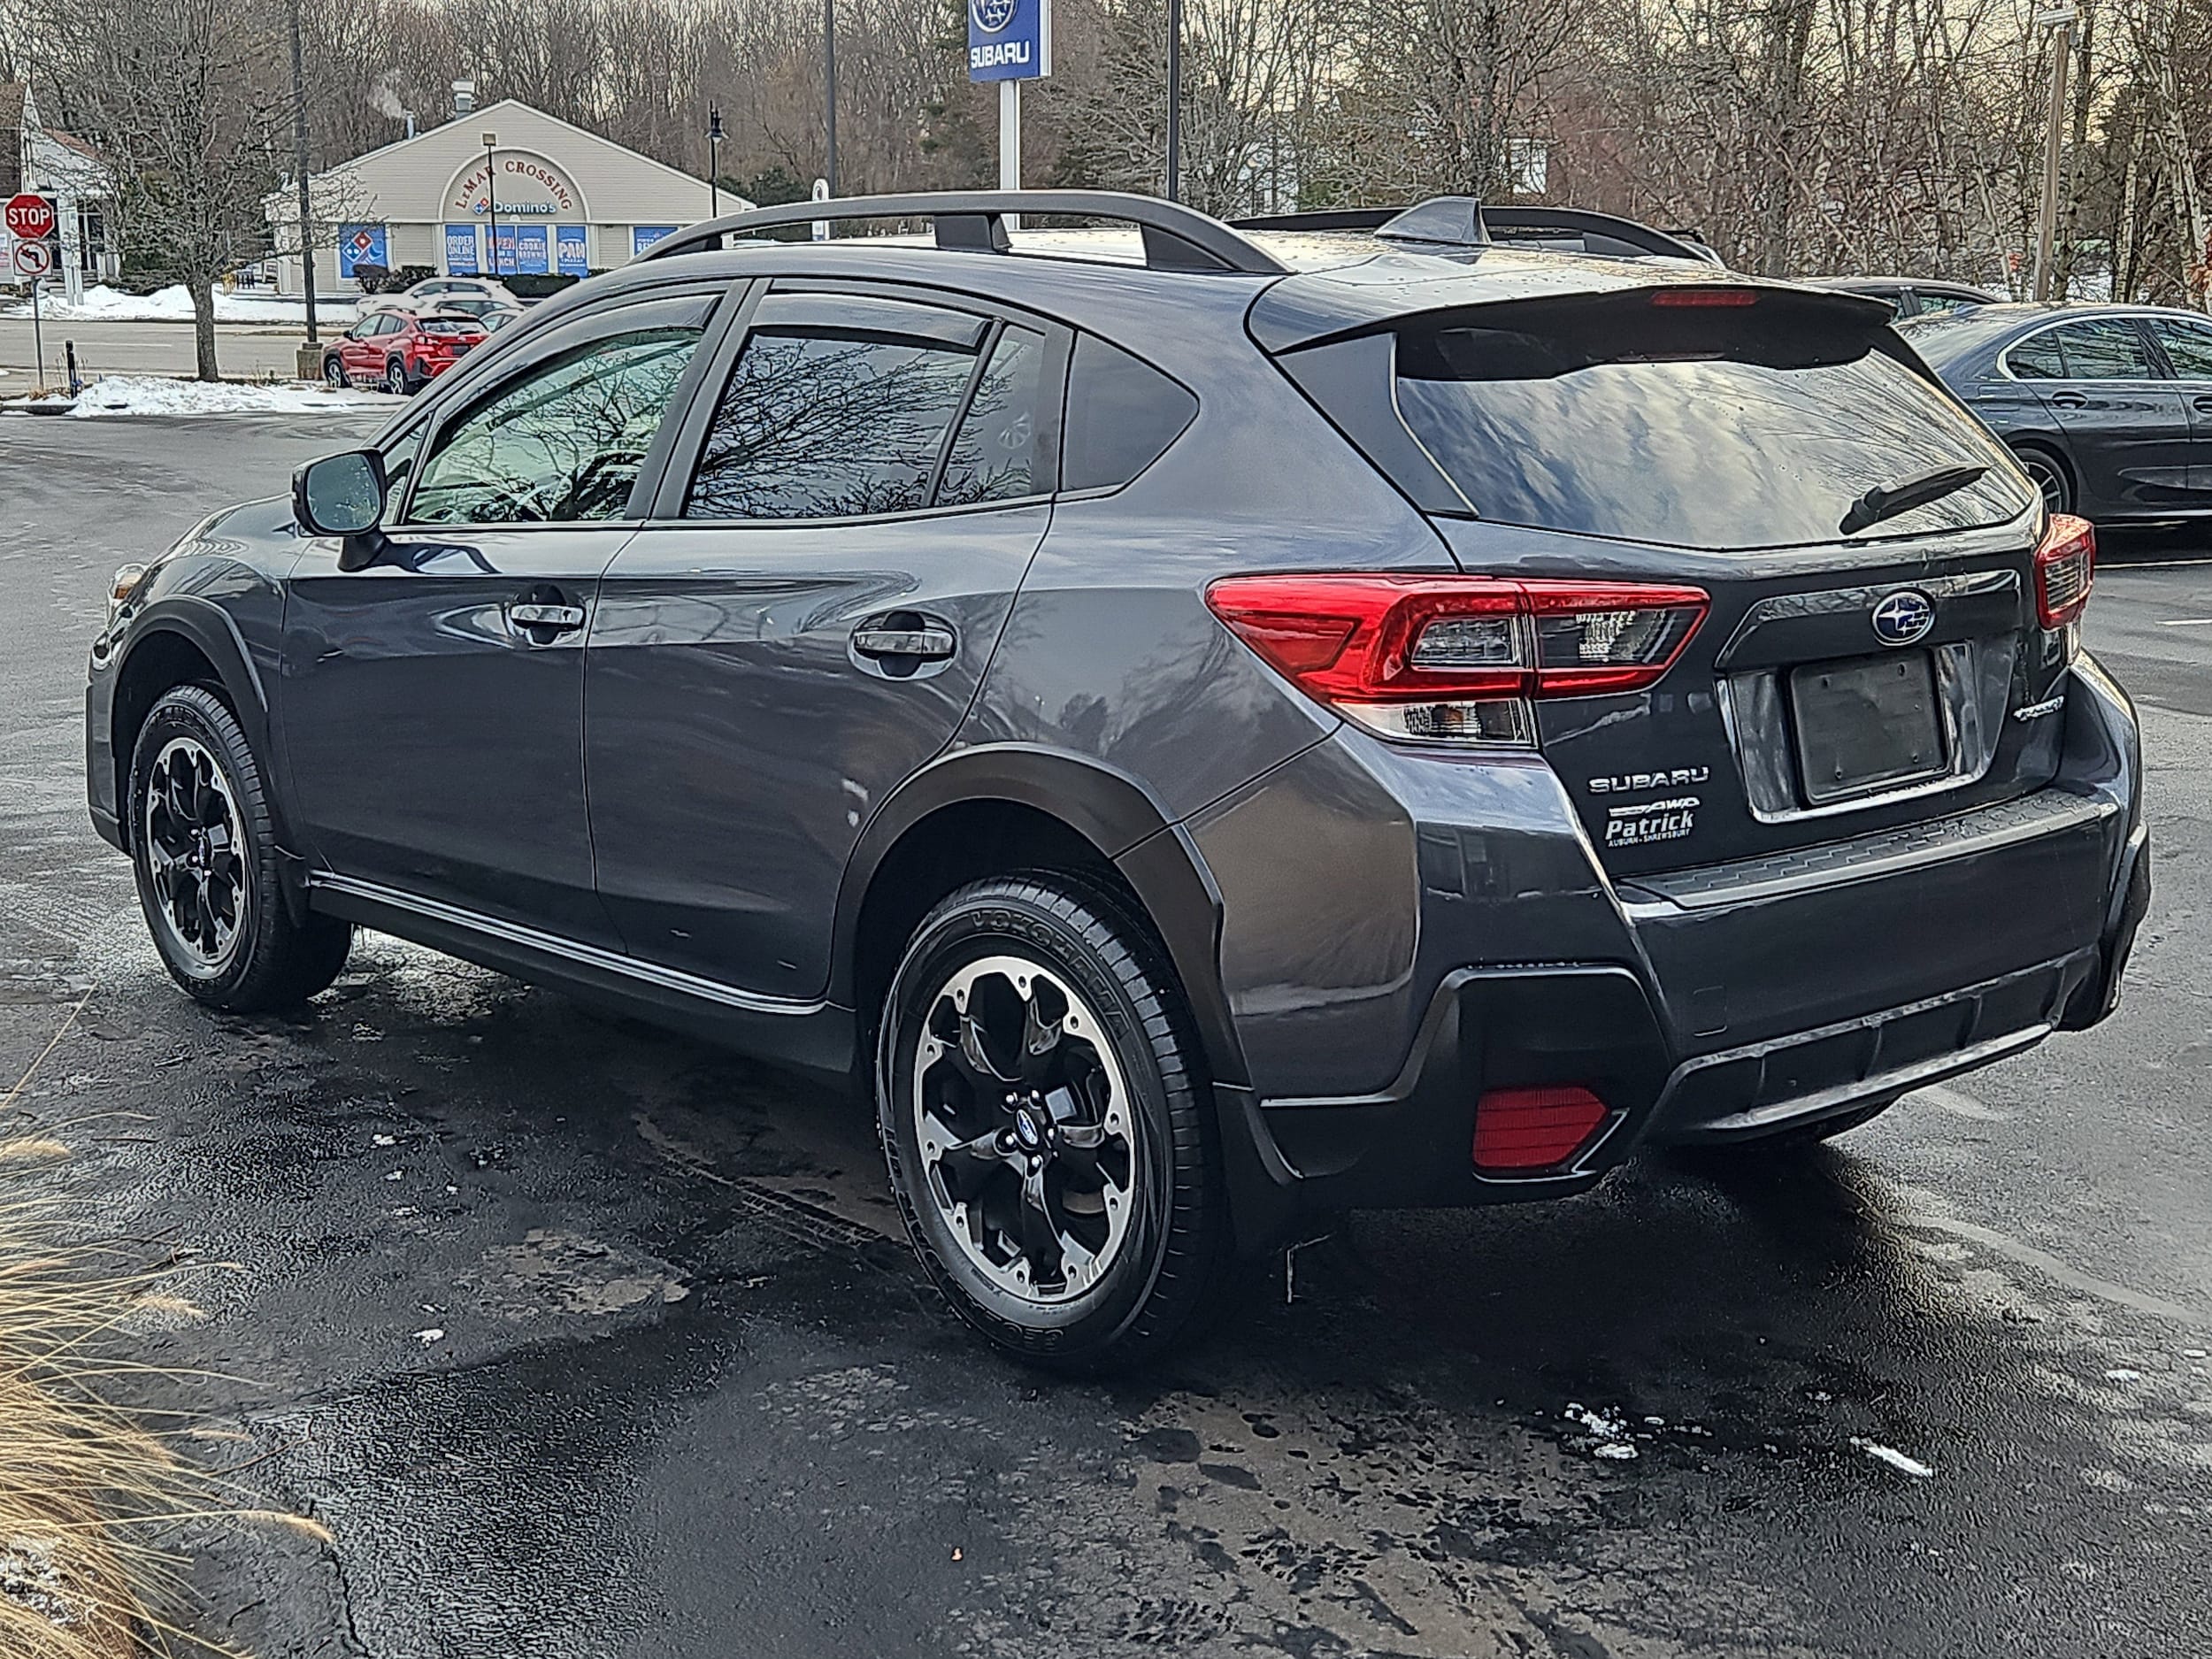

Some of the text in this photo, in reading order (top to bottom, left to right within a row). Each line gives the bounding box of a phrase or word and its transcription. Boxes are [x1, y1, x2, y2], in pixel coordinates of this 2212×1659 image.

[971, 40, 1030, 69] SUBARU
[505, 160, 572, 210] CROSSING
[8, 207, 50, 226] STOP
[494, 201, 557, 213] Domino's
[447, 235, 474, 245] ORDER
[448, 245, 475, 255] ONLINE
[1589, 766, 1709, 794] SUBARU
[1605, 810, 1694, 840] Patrick
[971, 910, 1130, 1041] YOKOHAMA
